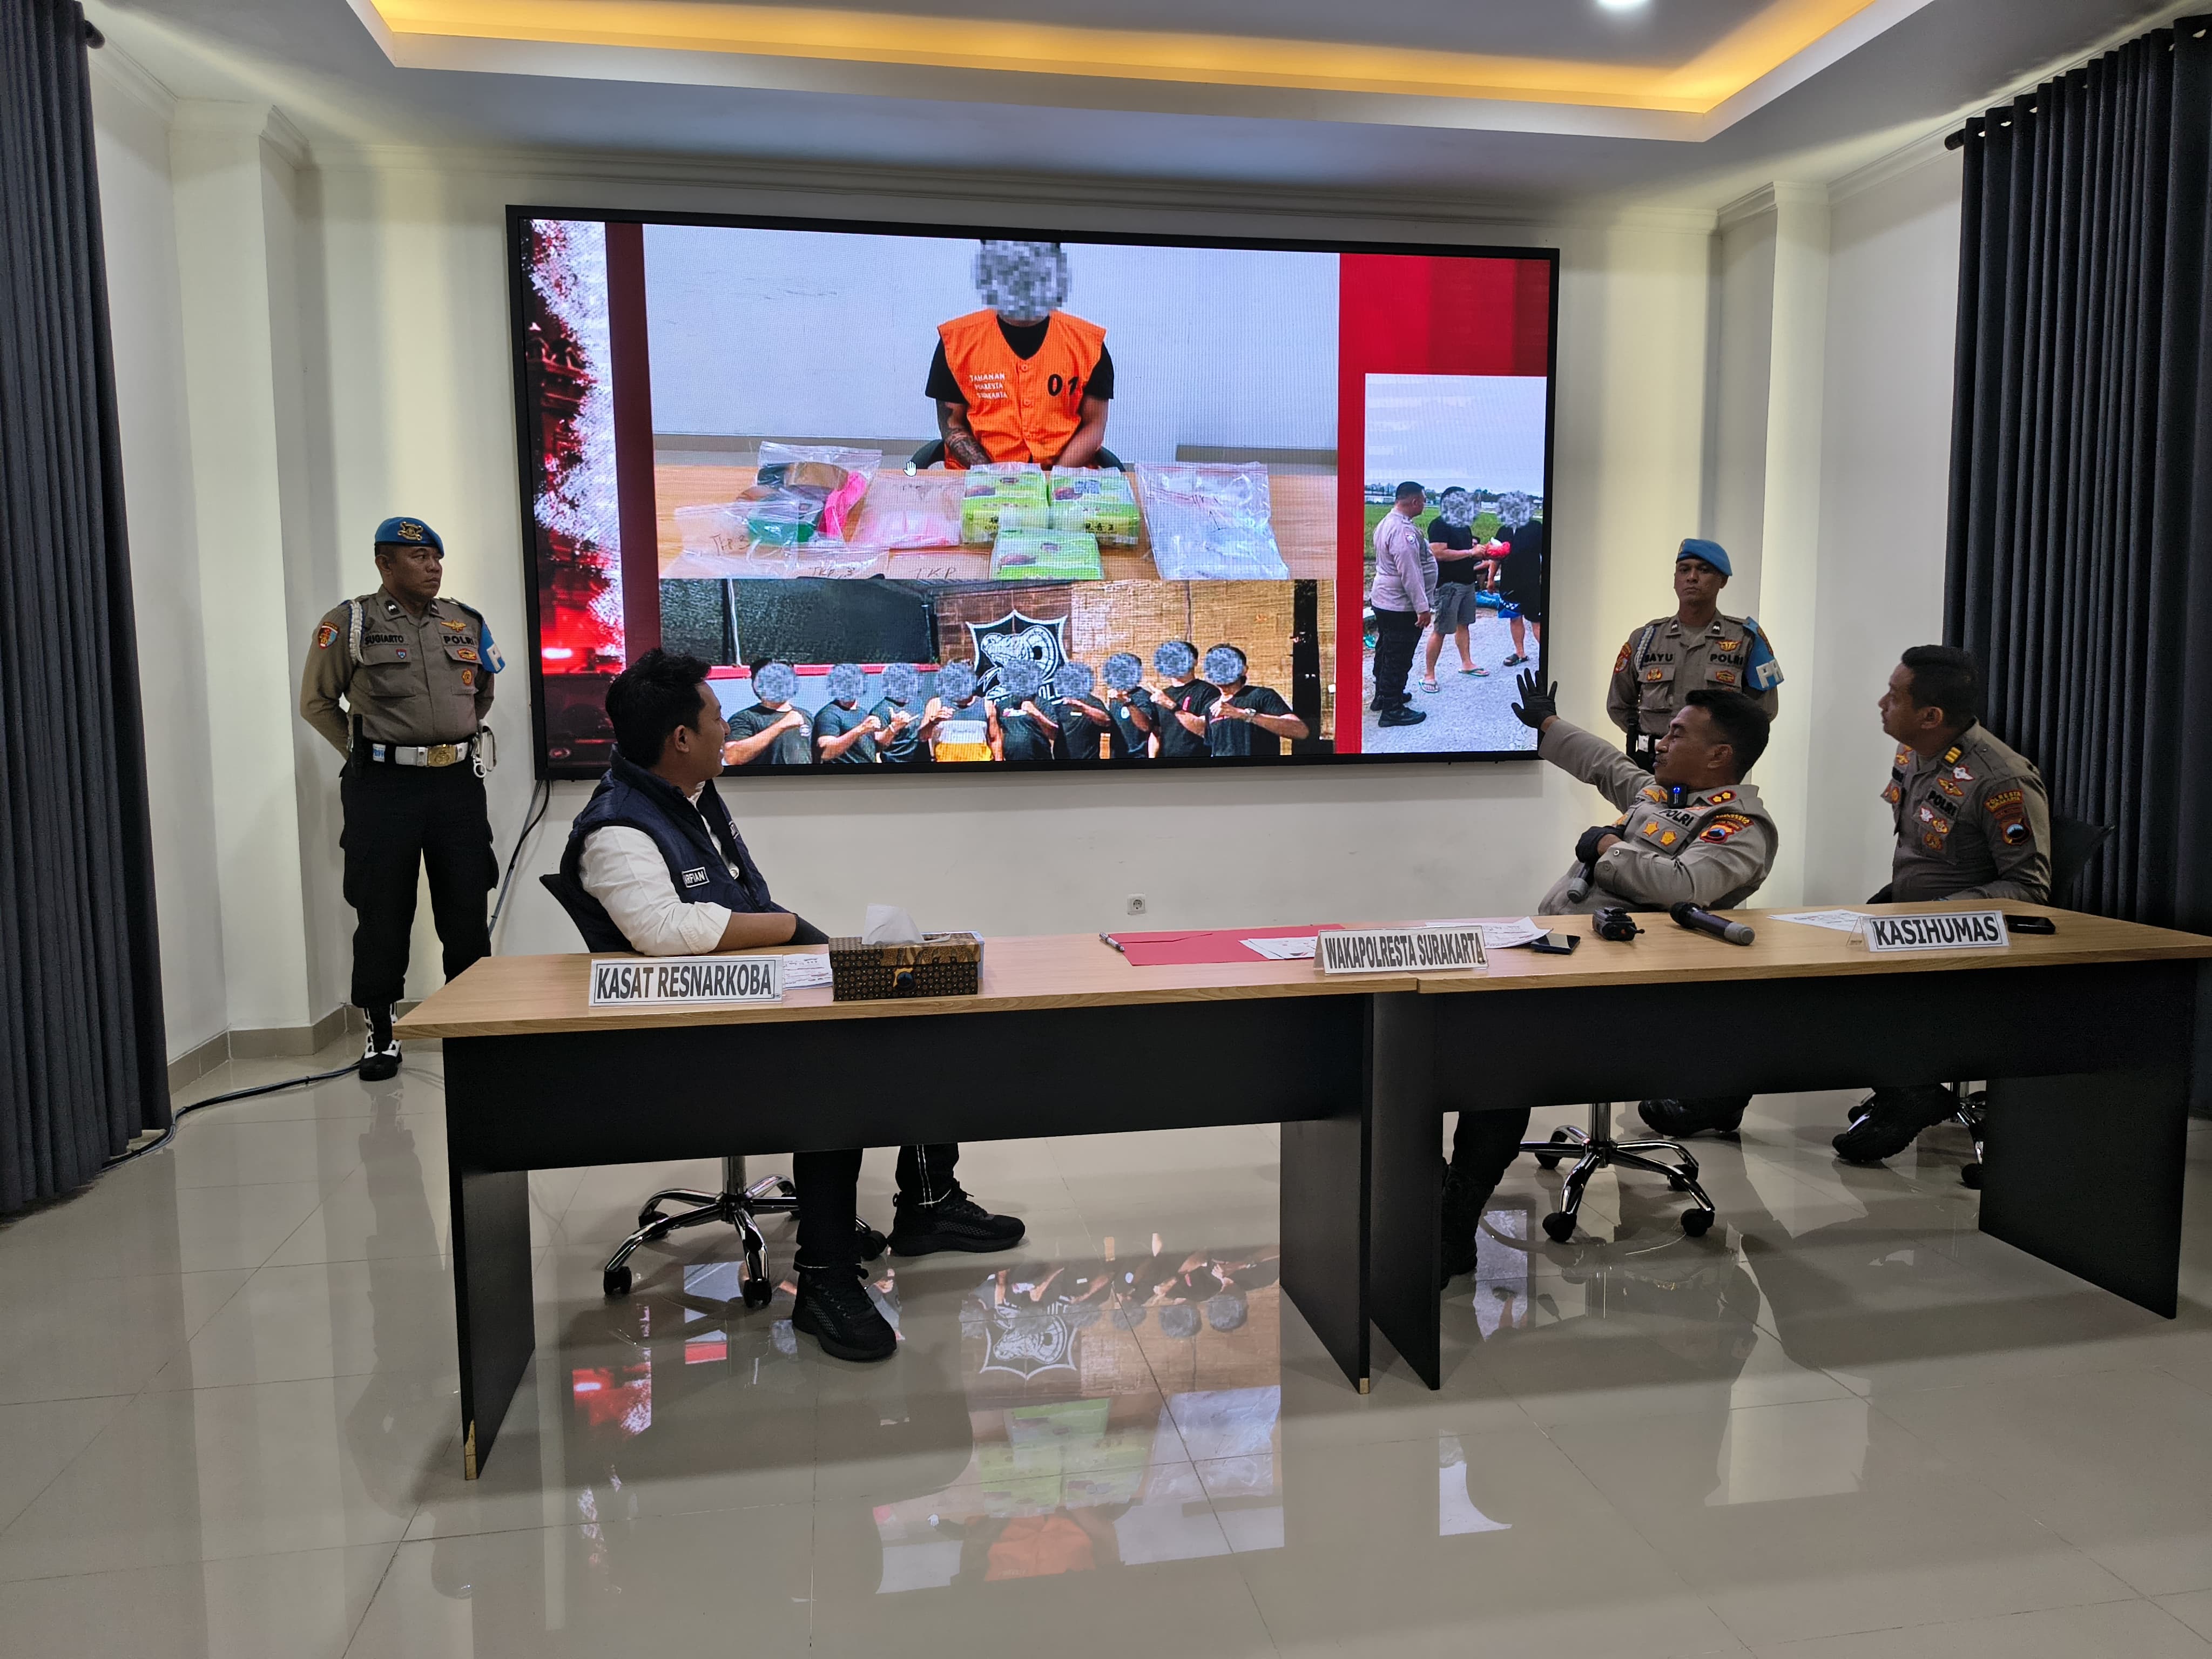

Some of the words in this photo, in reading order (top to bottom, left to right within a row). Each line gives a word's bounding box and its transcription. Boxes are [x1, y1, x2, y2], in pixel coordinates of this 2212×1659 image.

[1048, 373, 1080, 396] 01
[365, 634, 404, 645] SUGIARTO
[443, 635, 475, 645] POLRI
[1710, 653, 1744, 665] POLRI
[1928, 790, 1957, 816] POLRI
[1659, 810, 1694, 827] POLRI
[1872, 916, 1999, 946] KASIHUMAS
[1324, 935, 1418, 969] WAKAPOLRESTA
[1417, 932, 1483, 966] SURAKARTA
[597, 967, 655, 999] KASAT
[658, 963, 772, 999] RESNARKOBA
